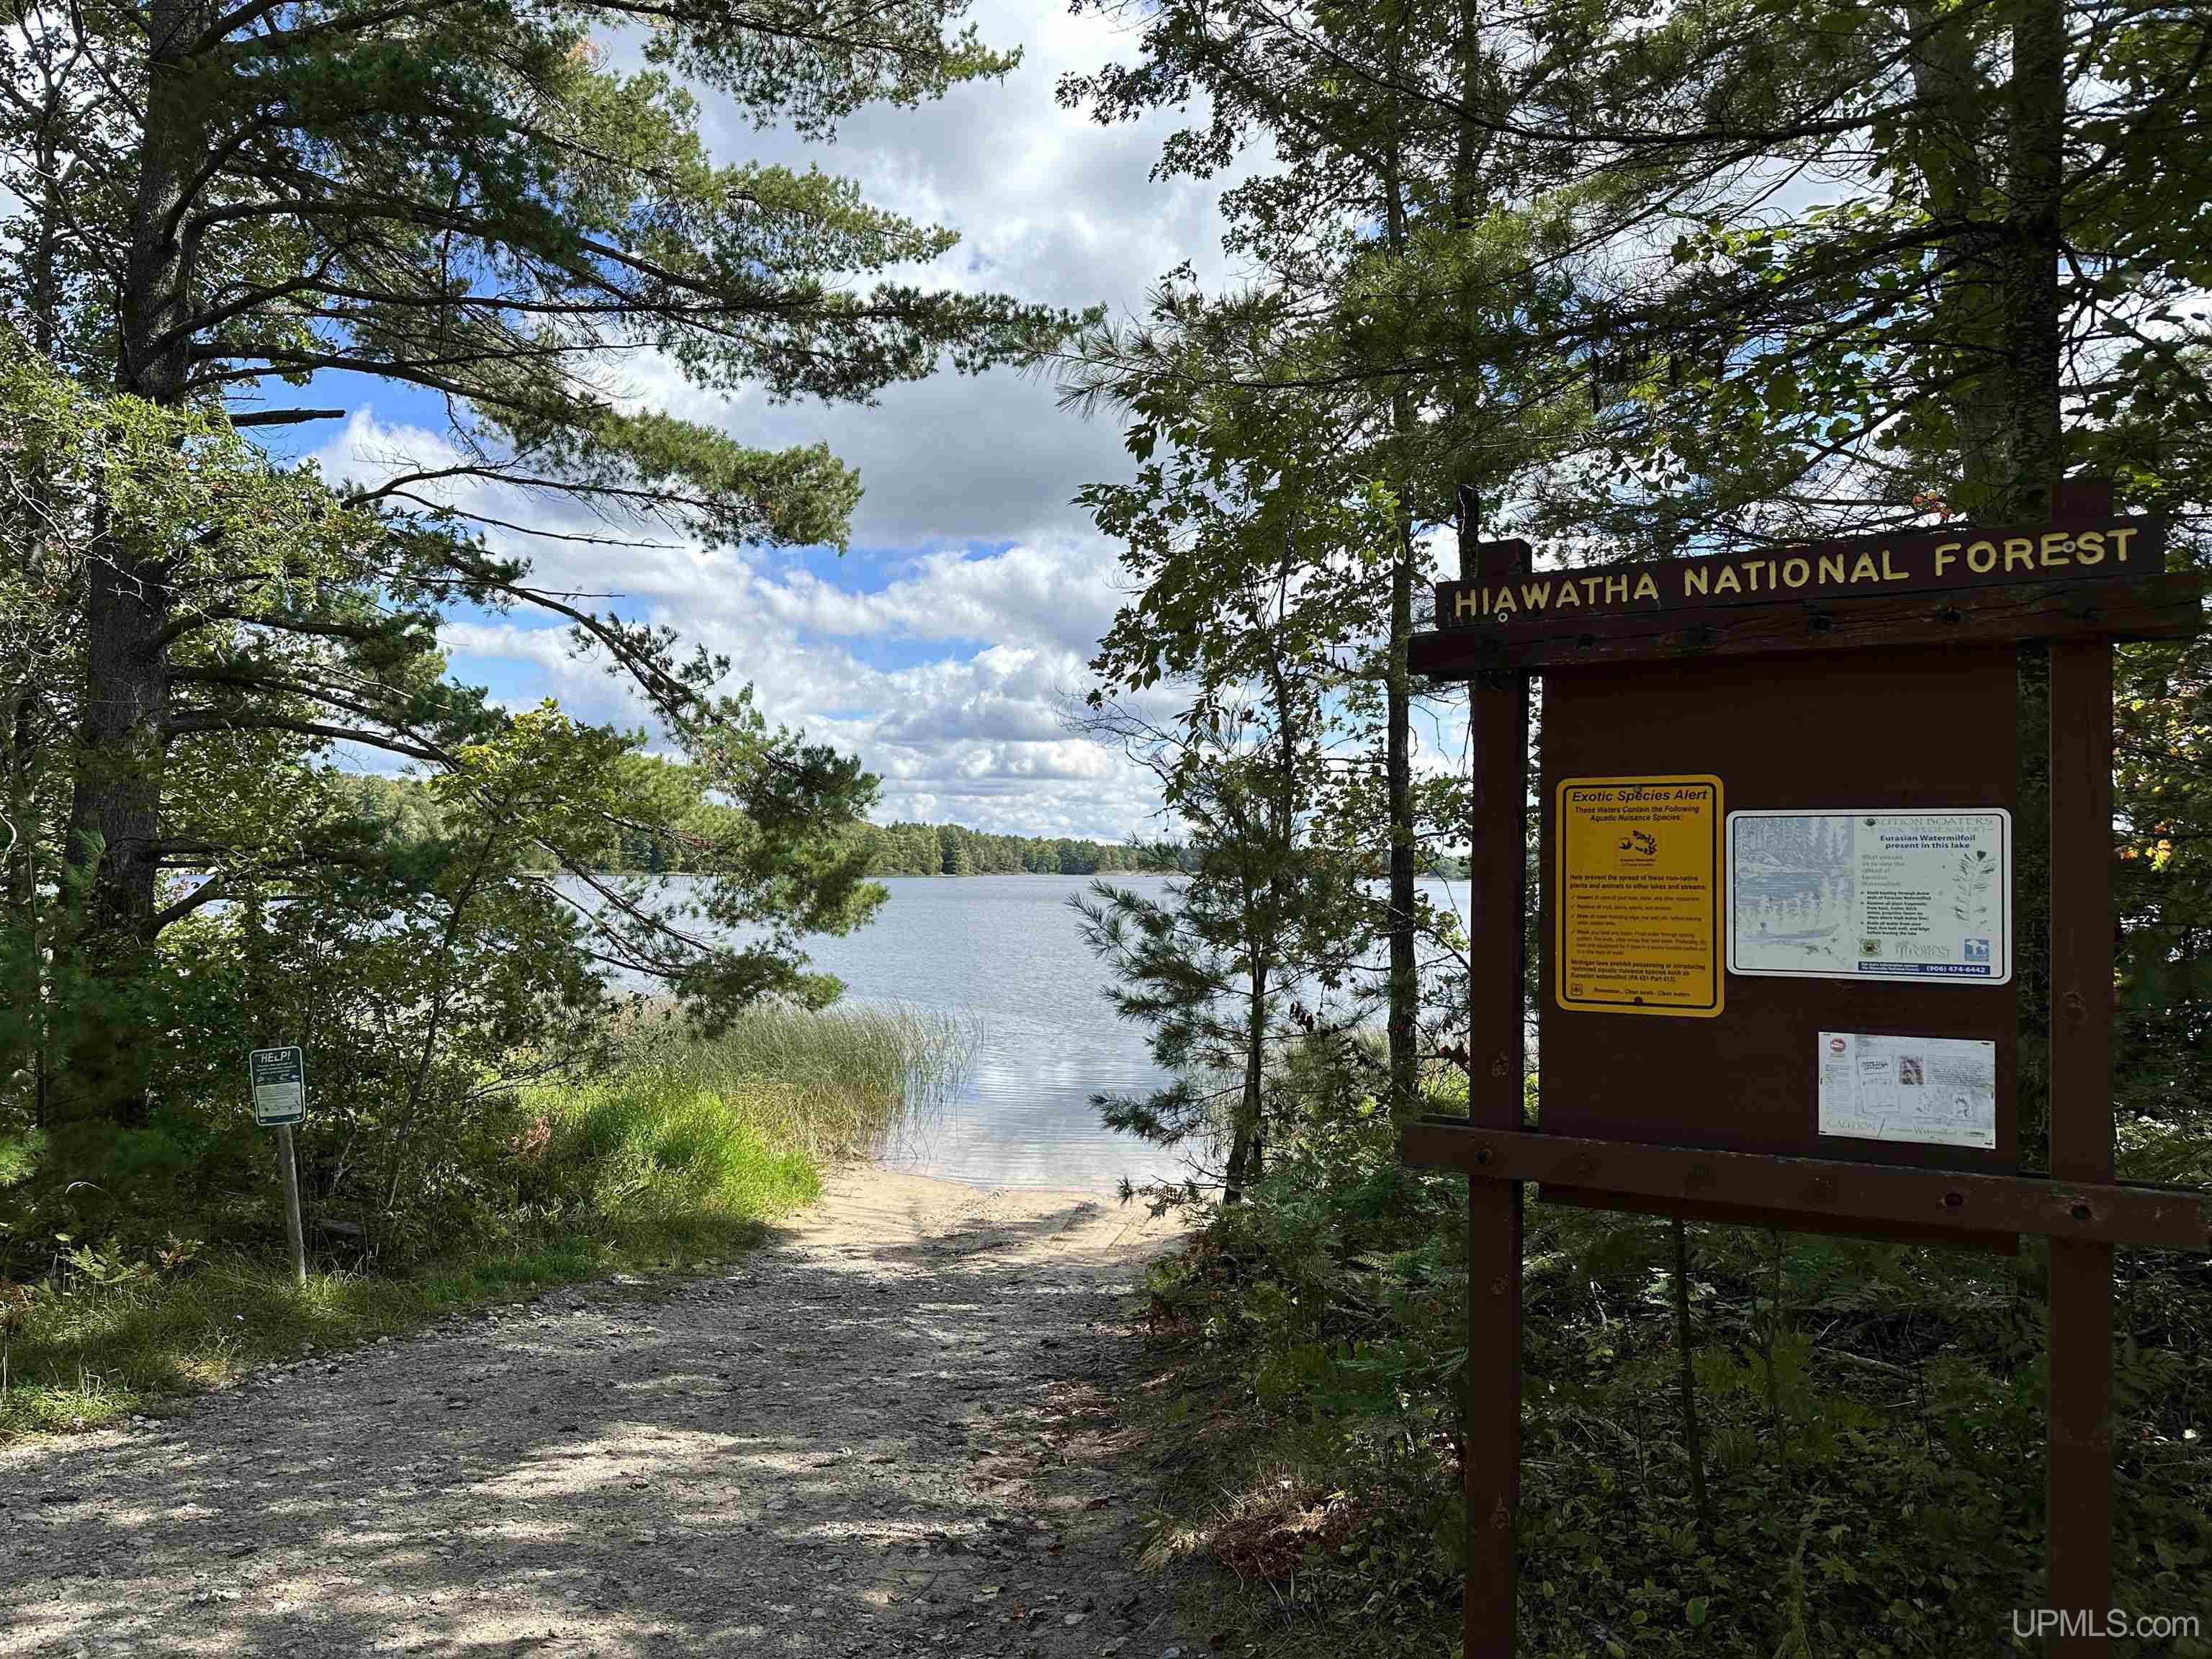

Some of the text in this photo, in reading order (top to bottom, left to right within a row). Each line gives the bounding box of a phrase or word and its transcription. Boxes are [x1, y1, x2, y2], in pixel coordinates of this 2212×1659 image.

[1455, 528, 2138, 617] HIAWATHA NATIONAL FOREST
[1572, 788, 1707, 804] Exotic Species Alert
[1664, 805, 1700, 814] Following
[261, 1051, 291, 1064] HELP!
